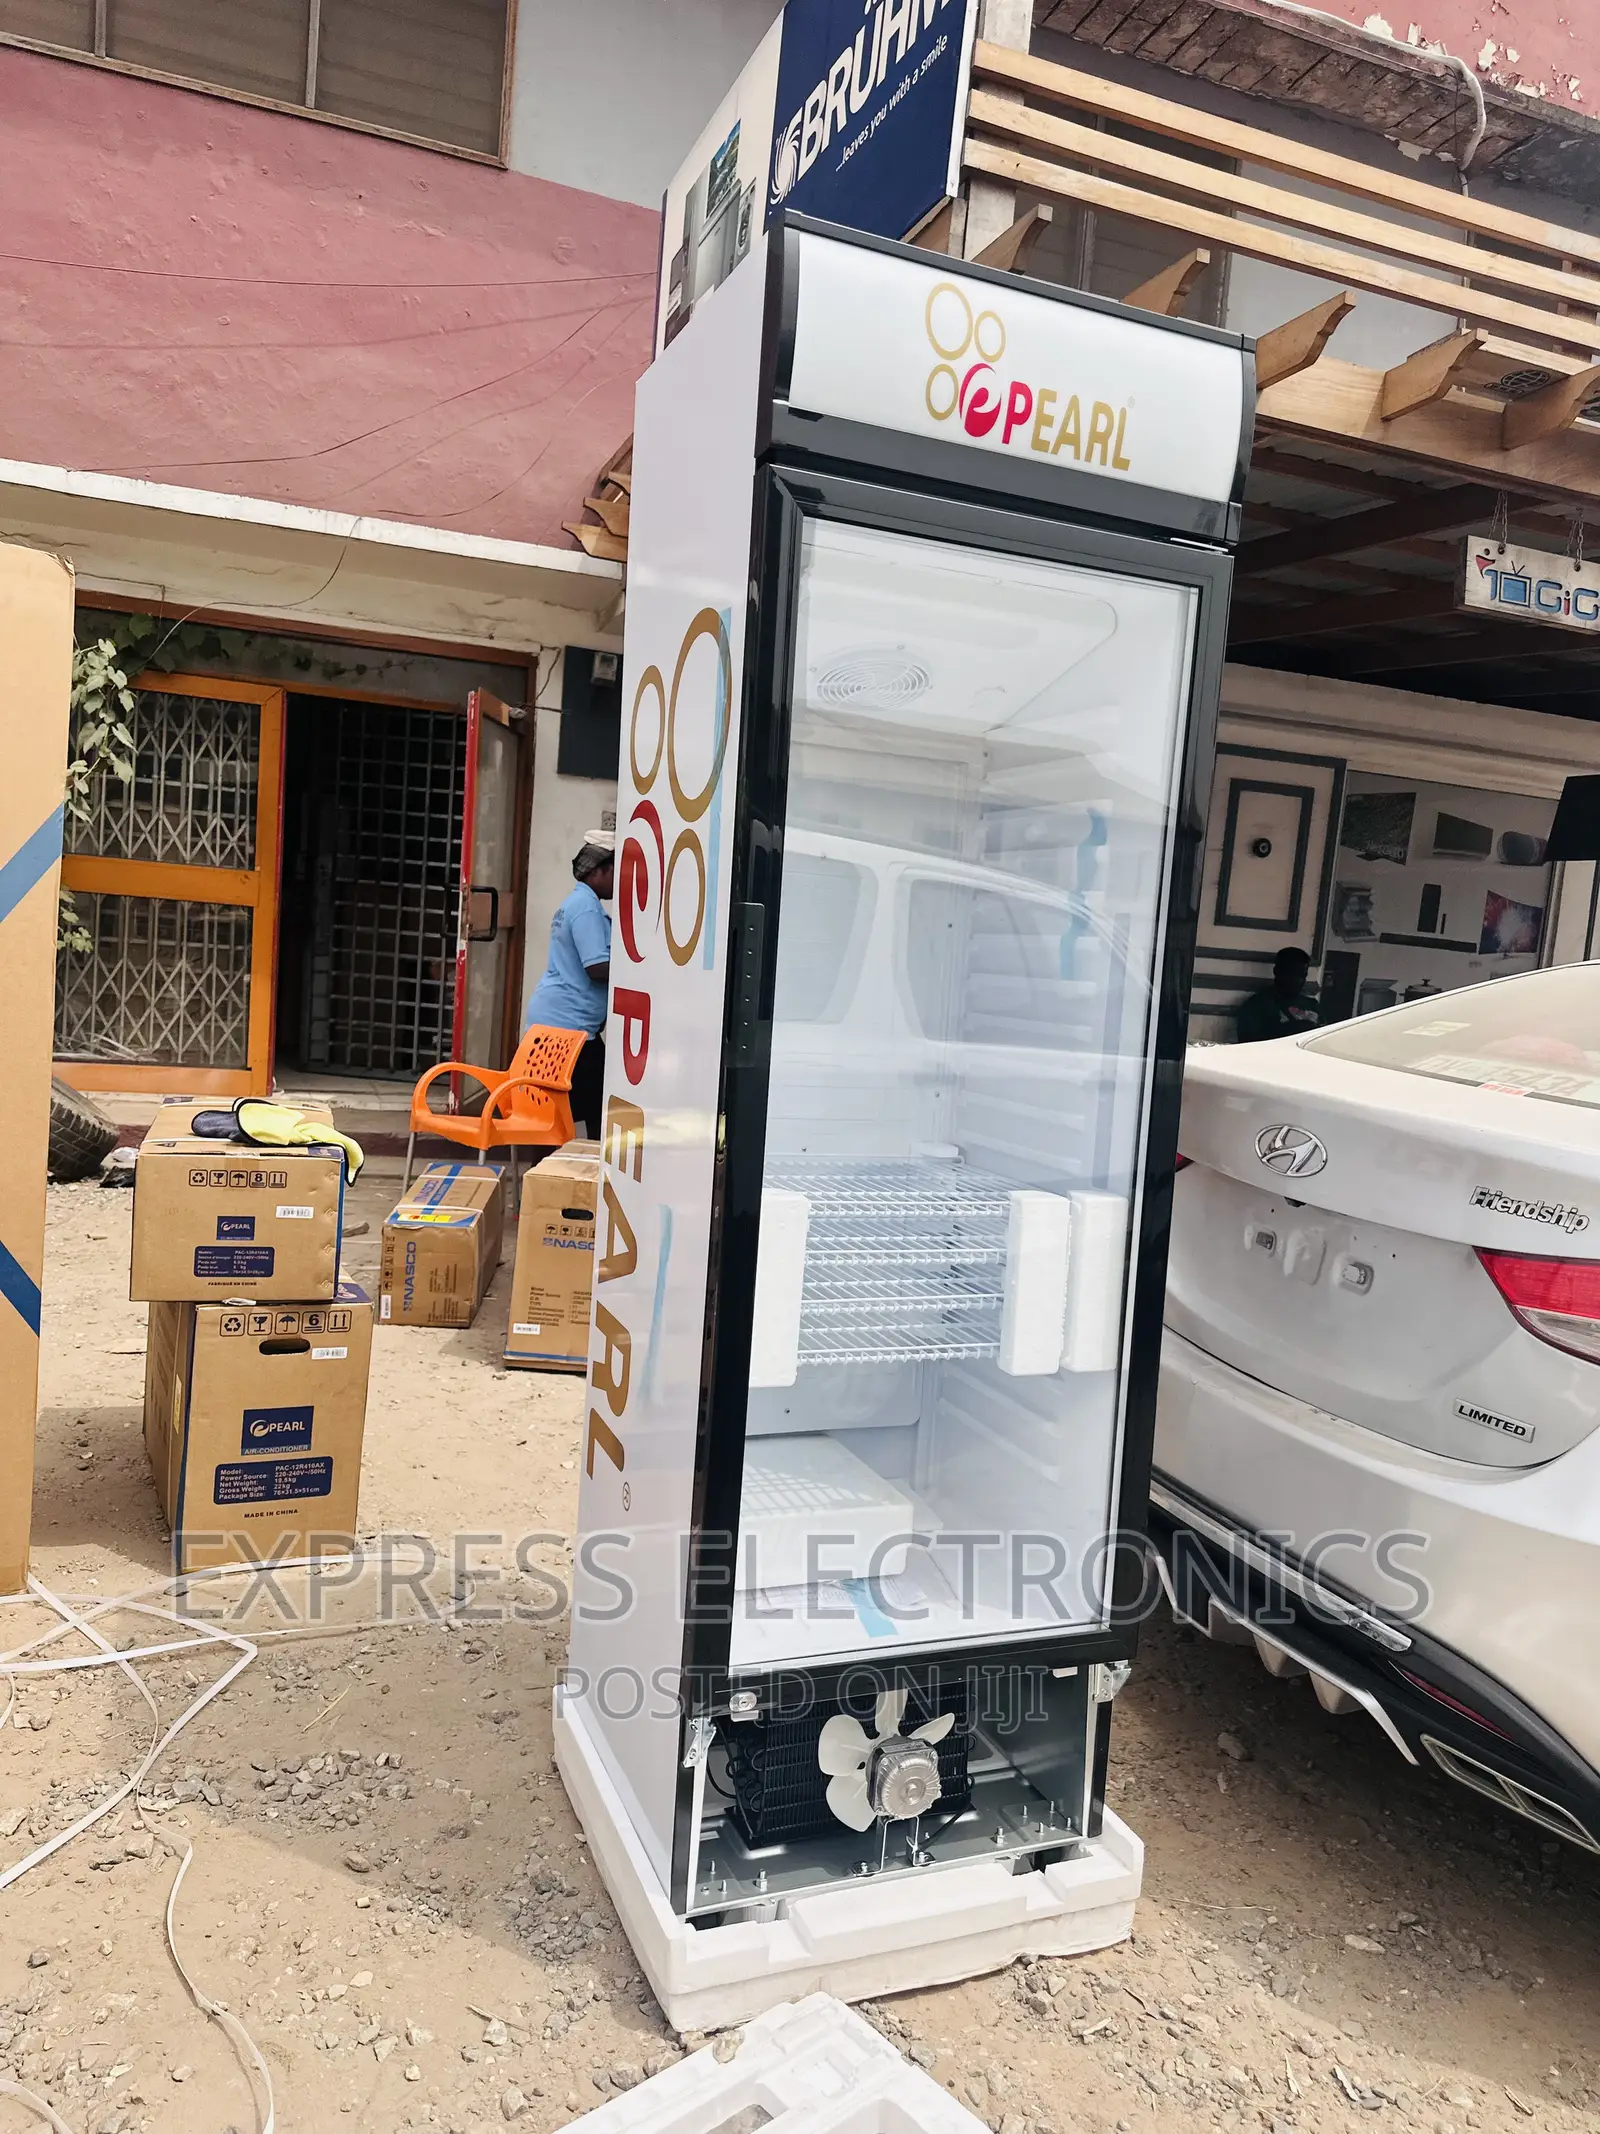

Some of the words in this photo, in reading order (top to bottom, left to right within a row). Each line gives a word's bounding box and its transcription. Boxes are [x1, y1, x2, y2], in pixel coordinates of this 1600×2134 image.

[869, 104, 888, 138] you
[889, 75, 911, 111] with
[912, 68, 919, 85] a
[920, 34, 948, 76] smile
[1001, 380, 1131, 471] PEARL
[1469, 1185, 1590, 1234] Friendship
[553, 1238, 595, 1251] NASC
[586, 986, 652, 1481] PEARL
[404, 1241, 417, 1302] NASCO
[309, 1314, 320, 1326] 6
[269, 1421, 306, 1433] PEARL
[1457, 1404, 1527, 1437] LIMITED
[244, 1444, 309, 1455] AIR-CONDITIONER
